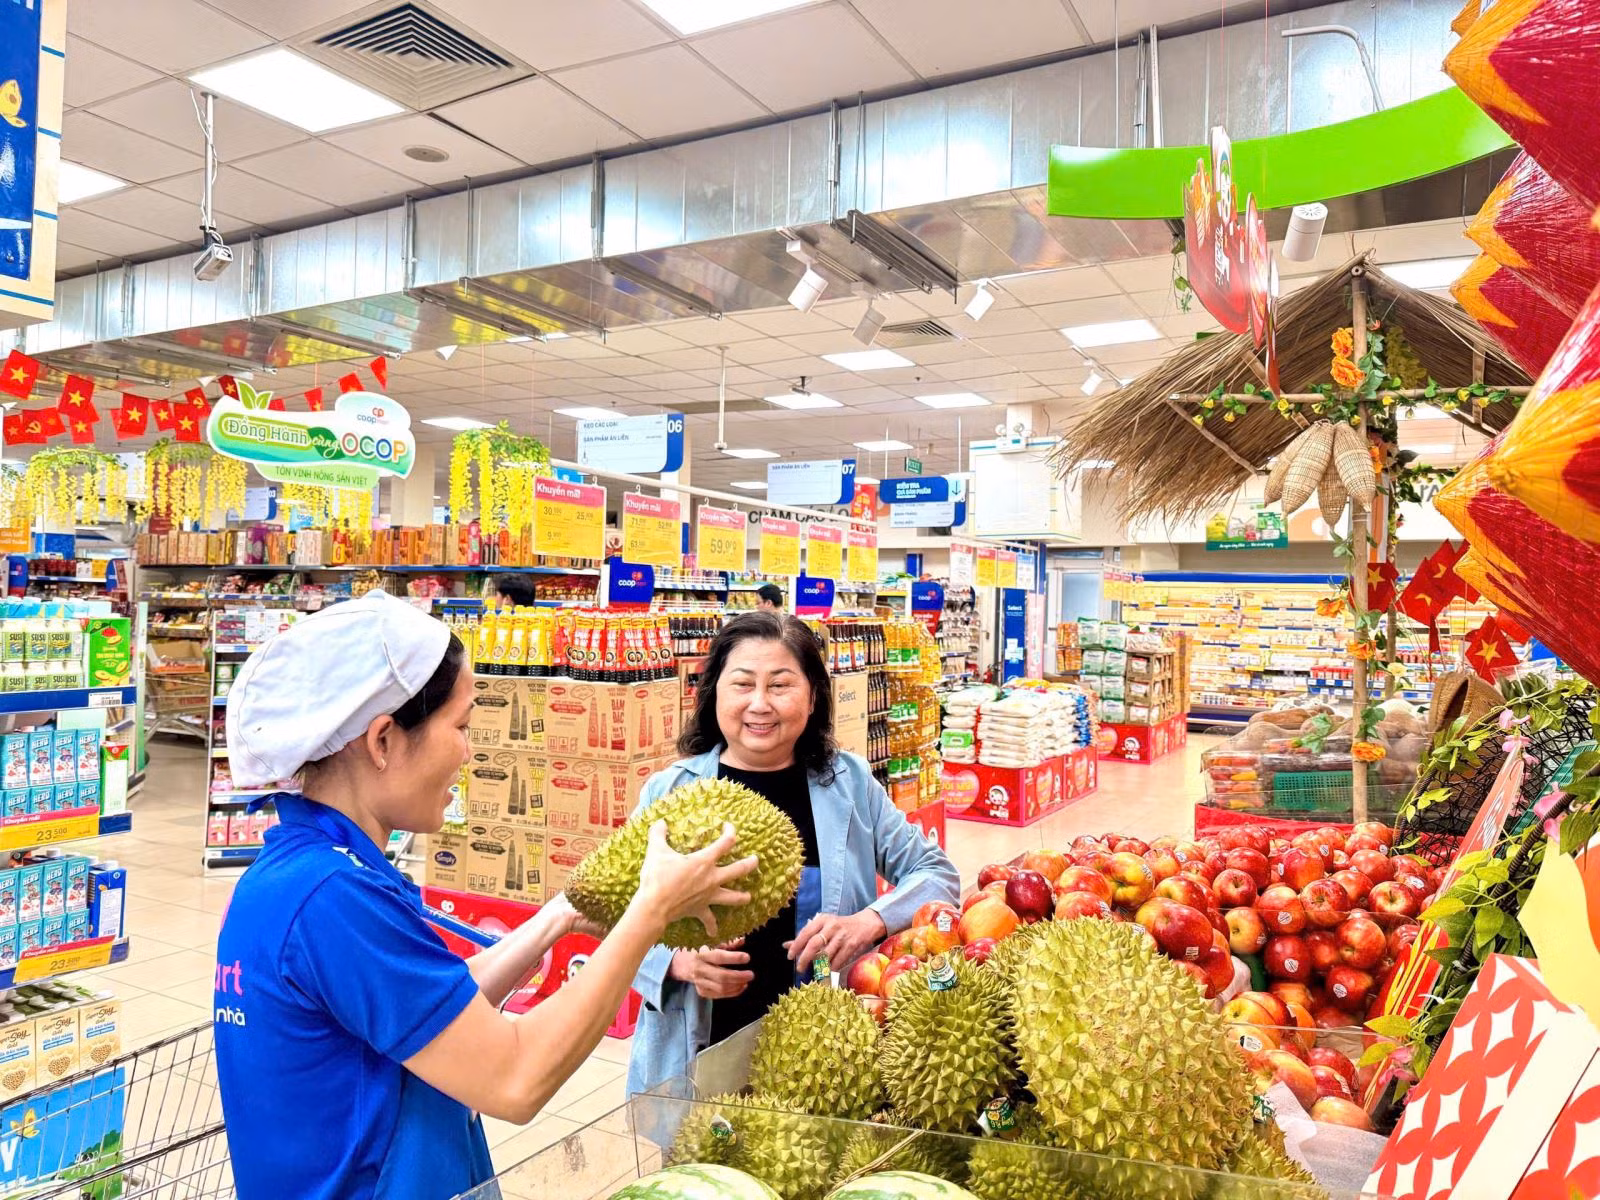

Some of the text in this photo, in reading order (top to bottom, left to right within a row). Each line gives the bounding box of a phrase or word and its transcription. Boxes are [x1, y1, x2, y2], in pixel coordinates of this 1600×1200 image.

[667, 419, 682, 433] 06
[228, 416, 266, 441] Đồng
[270, 425, 307, 445] Hành
[341, 432, 407, 462] OCOP
[275, 466, 291, 477] TÔN
[292, 468, 312, 479] VINH
[313, 469, 334, 481] NÔNG
[842, 464, 855, 474] 07
[536, 483, 566, 498] Khuyến
[626, 500, 649, 512] Khuyến
[215, 1006, 246, 1026] nhà
